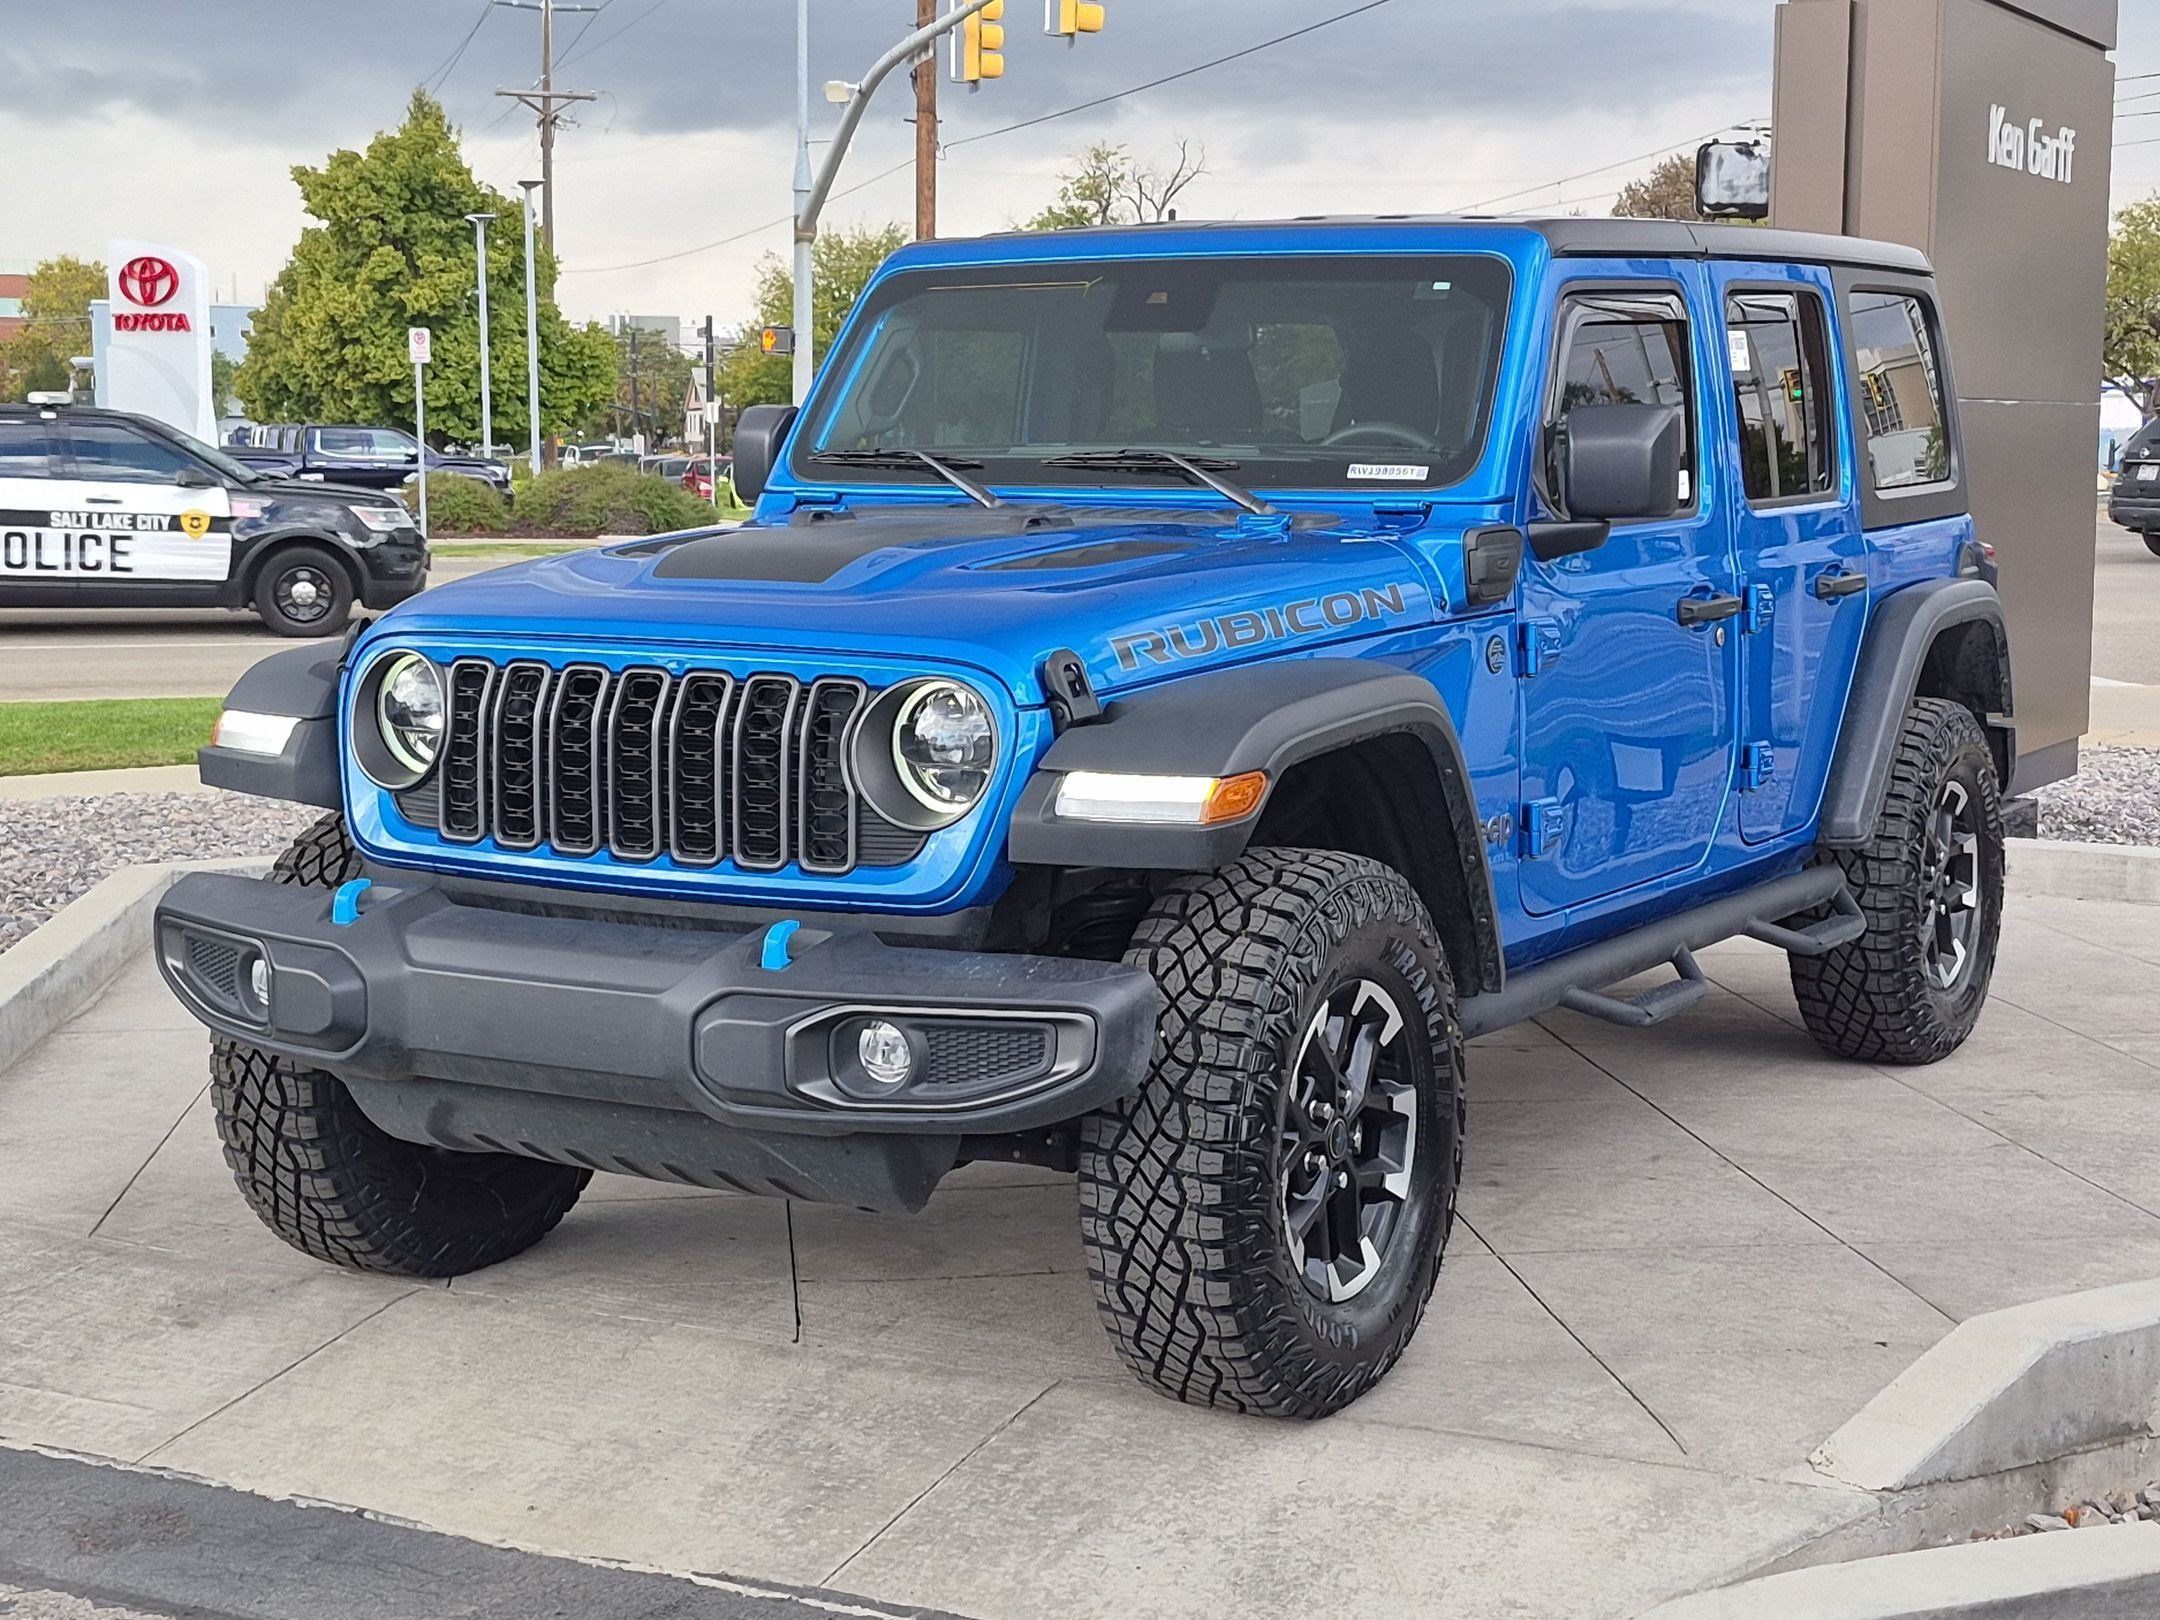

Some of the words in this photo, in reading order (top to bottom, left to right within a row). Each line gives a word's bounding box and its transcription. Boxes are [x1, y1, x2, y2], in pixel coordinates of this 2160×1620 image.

[1988, 104, 2024, 171] Ken
[2027, 118, 2076, 184] Garff
[112, 313, 191, 332] TOYOTA
[50, 511, 89, 529] SALT
[91, 512, 133, 530] LAKE
[136, 515, 172, 531] CITY
[1109, 583, 1407, 672] RUBICON
[1379, 935, 1453, 1119] WRANGLER
